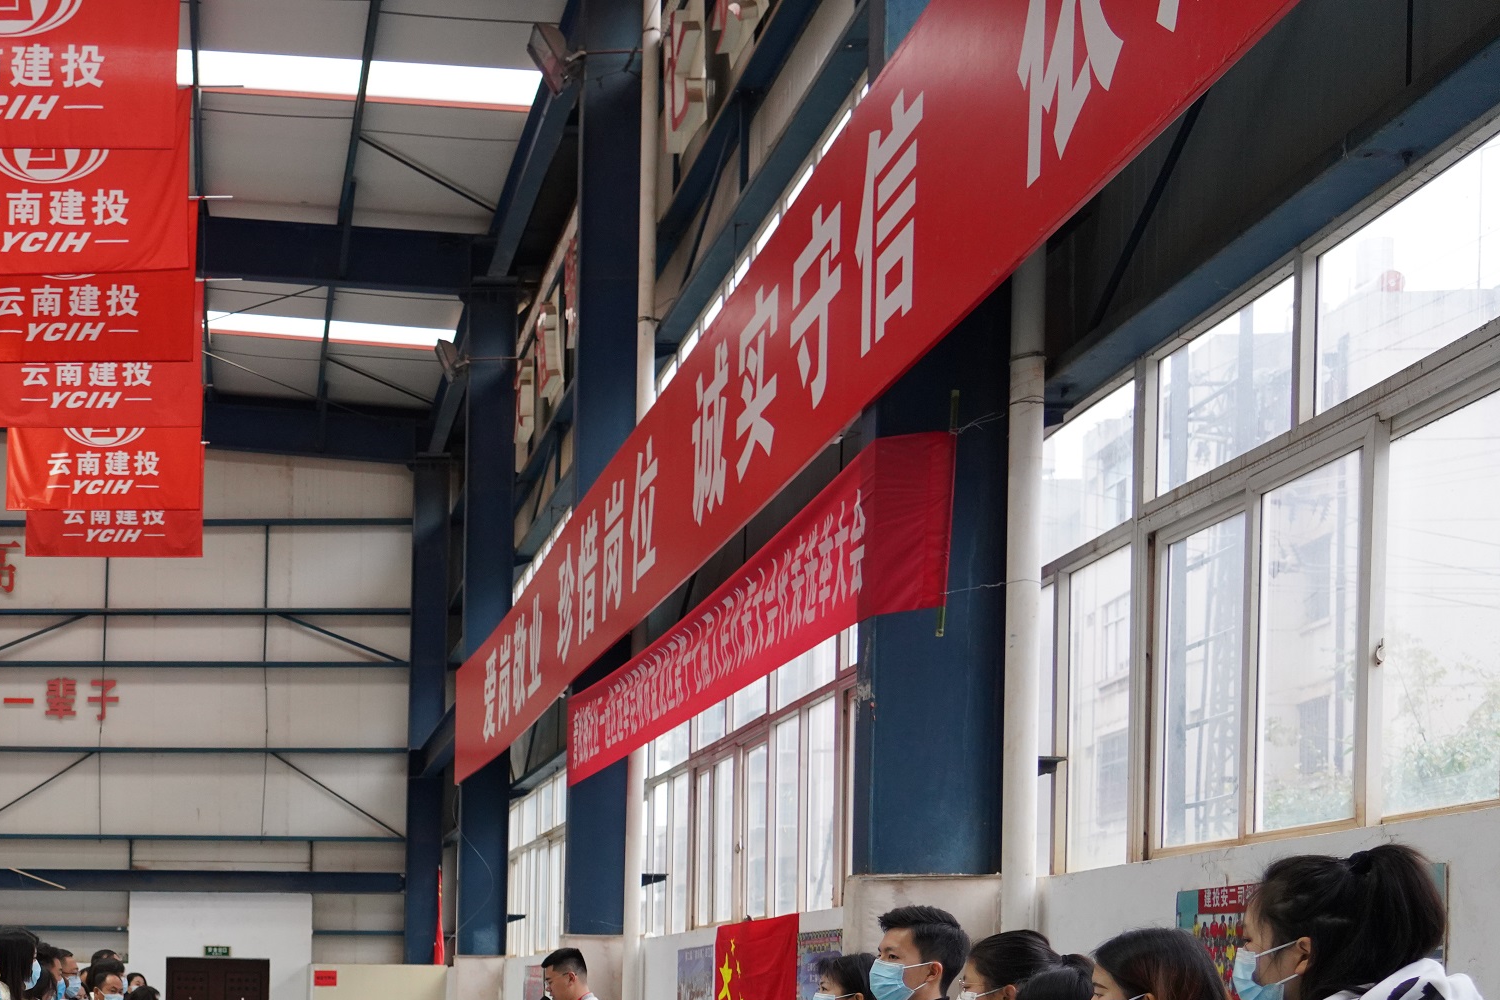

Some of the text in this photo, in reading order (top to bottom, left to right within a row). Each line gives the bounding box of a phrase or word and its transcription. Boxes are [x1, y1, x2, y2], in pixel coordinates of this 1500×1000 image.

[1, 232, 91, 252] YCIH
[26, 322, 105, 341] YCIH
[21, 362, 152, 387] 云南建投
[50, 391, 122, 408] YCIH
[482, 593, 543, 743] 爱岗敬业
[557, 436, 658, 665] 珍惜岗位
[692, 88, 924, 526] 诚实守信
[47, 450, 159, 476] 云南建投
[71, 480, 134, 494] YCIH
[62, 510, 166, 526] 云南建投
[86, 529, 142, 542] YCIH
